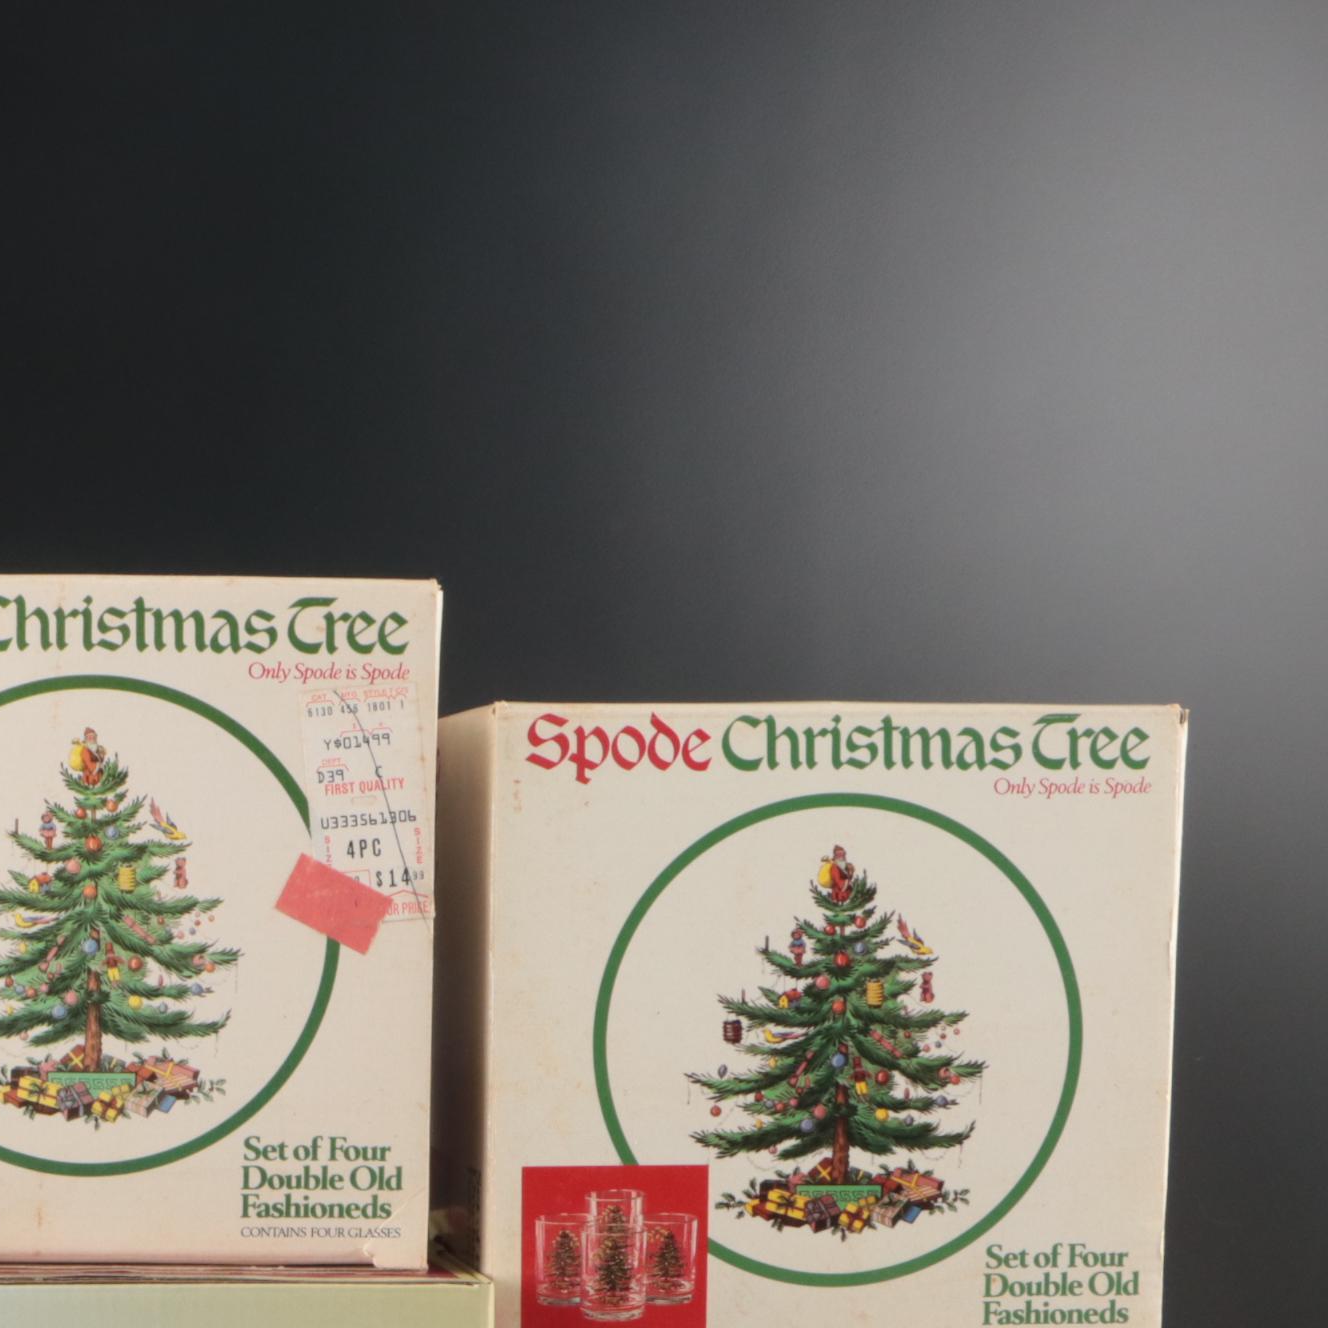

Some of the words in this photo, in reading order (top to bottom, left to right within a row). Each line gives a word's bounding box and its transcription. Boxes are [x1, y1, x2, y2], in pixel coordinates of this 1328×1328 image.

[285, 597, 409, 656] Tree
[248, 661, 291, 683] Only
[294, 662, 341, 684] Spode
[346, 664, 357, 680] is
[361, 662, 410, 684] Spode
[525, 712, 712, 785] Spode
[721, 713, 1023, 772] Christmas
[1031, 713, 1151, 771] Tree
[324, 781, 356, 796] FIRST
[359, 777, 405, 794] QUALITY
[993, 777, 1036, 799] Only
[1038, 777, 1085, 799] Spode
[1089, 779, 1100, 795] is
[1104, 776, 1152, 799] Spode
[243, 1135, 289, 1162] Set
[293, 1135, 324, 1162] of
[328, 1136, 391, 1162] Four
[241, 1165, 344, 1190] Double
[350, 1165, 403, 1191] Old
[241, 1193, 392, 1219] Fashioneds
[241, 1226, 307, 1238] CONTAINS
[311, 1227, 345, 1238] FOUR
[348, 1227, 401, 1238] GLASSES
[985, 1244, 1030, 1269] Set
[1034, 1243, 1063, 1268] of
[1067, 1243, 1129, 1268] Four
[983, 1272, 1083, 1298] Double
[1088, 1271, 1140, 1296] Old
[982, 1299, 1129, 1325] Fashioneds
